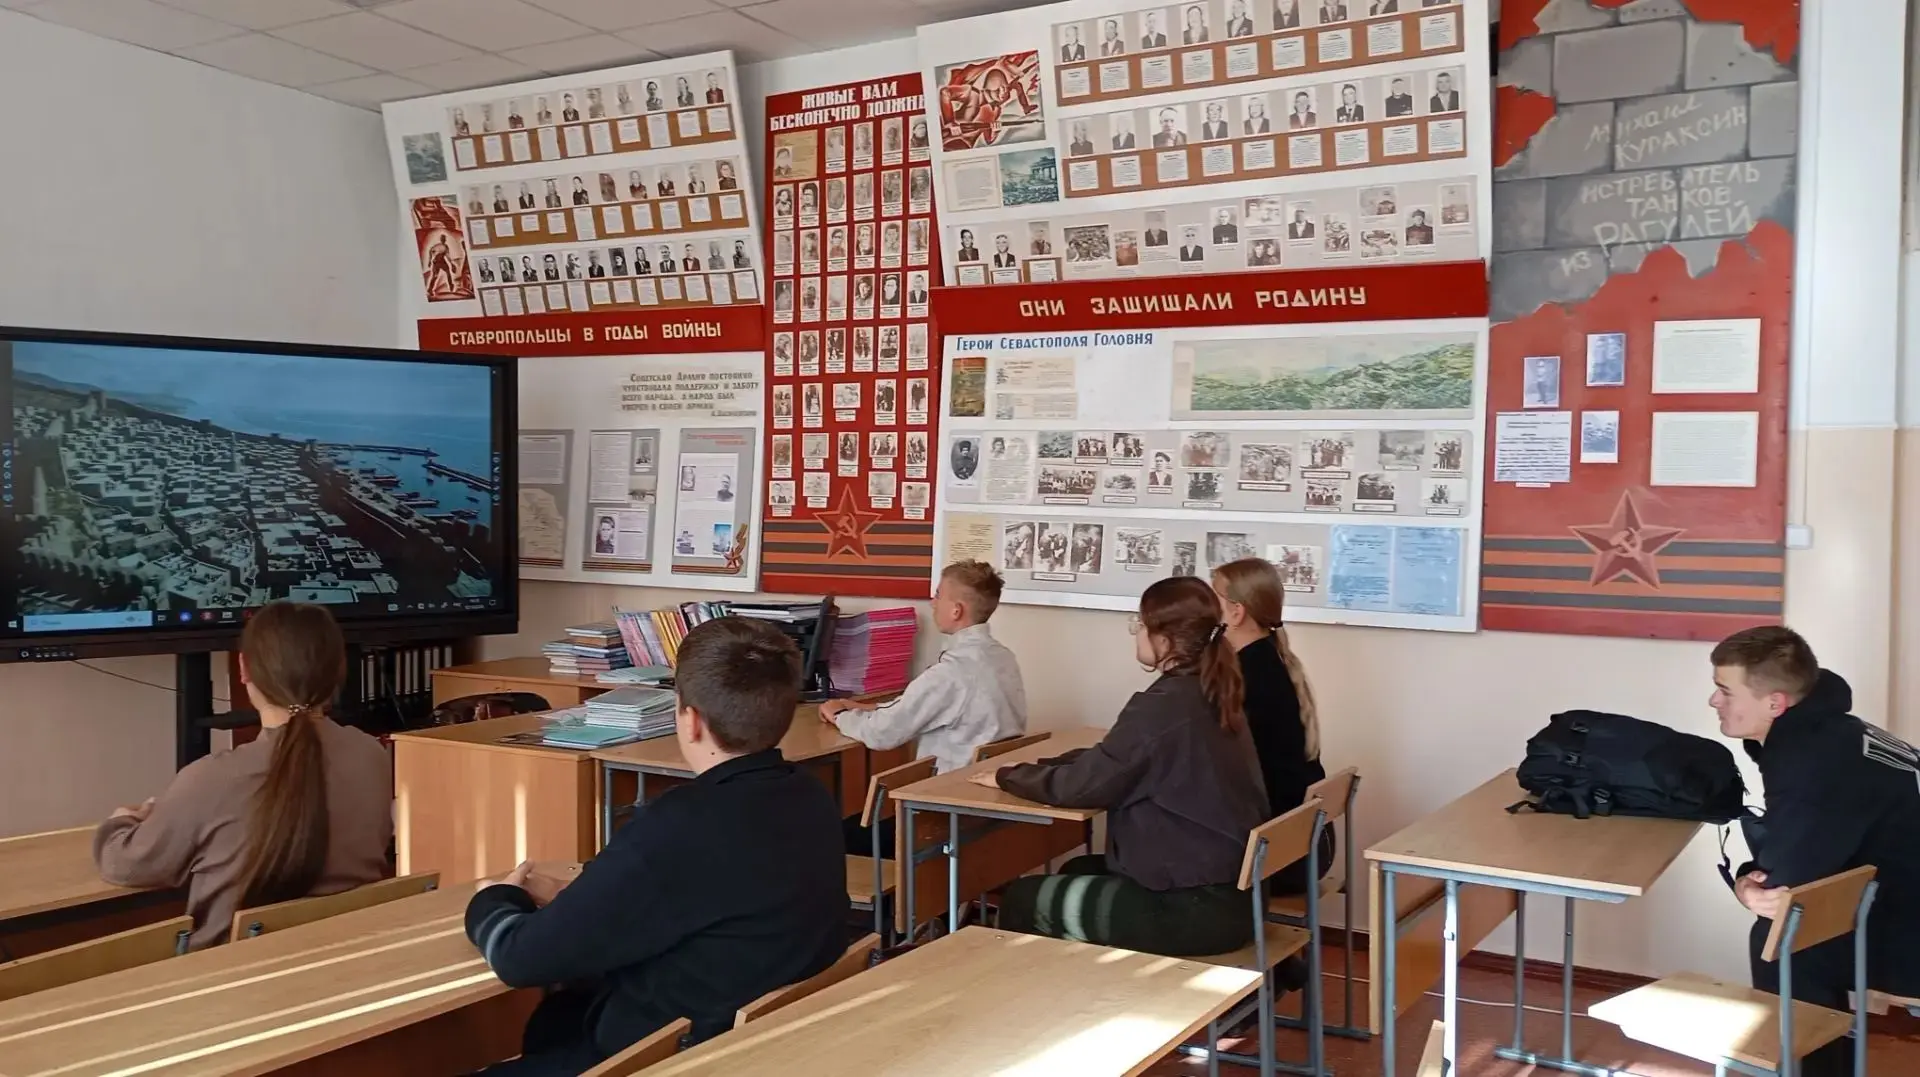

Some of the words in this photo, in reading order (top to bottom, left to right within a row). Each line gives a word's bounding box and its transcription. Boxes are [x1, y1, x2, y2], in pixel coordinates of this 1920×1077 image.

[801, 88, 857, 110] ЖИВЫЕ
[861, 81, 898, 100] ВАМ
[770, 104, 861, 131] БЕСКОНЕЧНО
[1625, 186, 1732, 219] ТАНКОВ
[1019, 299, 1066, 318] ОНИ
[1255, 286, 1367, 309] РОДИНУ
[449, 327, 572, 346] СТАВРОПОЛЬЦЫ
[583, 327, 594, 342] В
[605, 324, 648, 341] ГОДЫ
[662, 319, 722, 338] ВОЙНЫ
